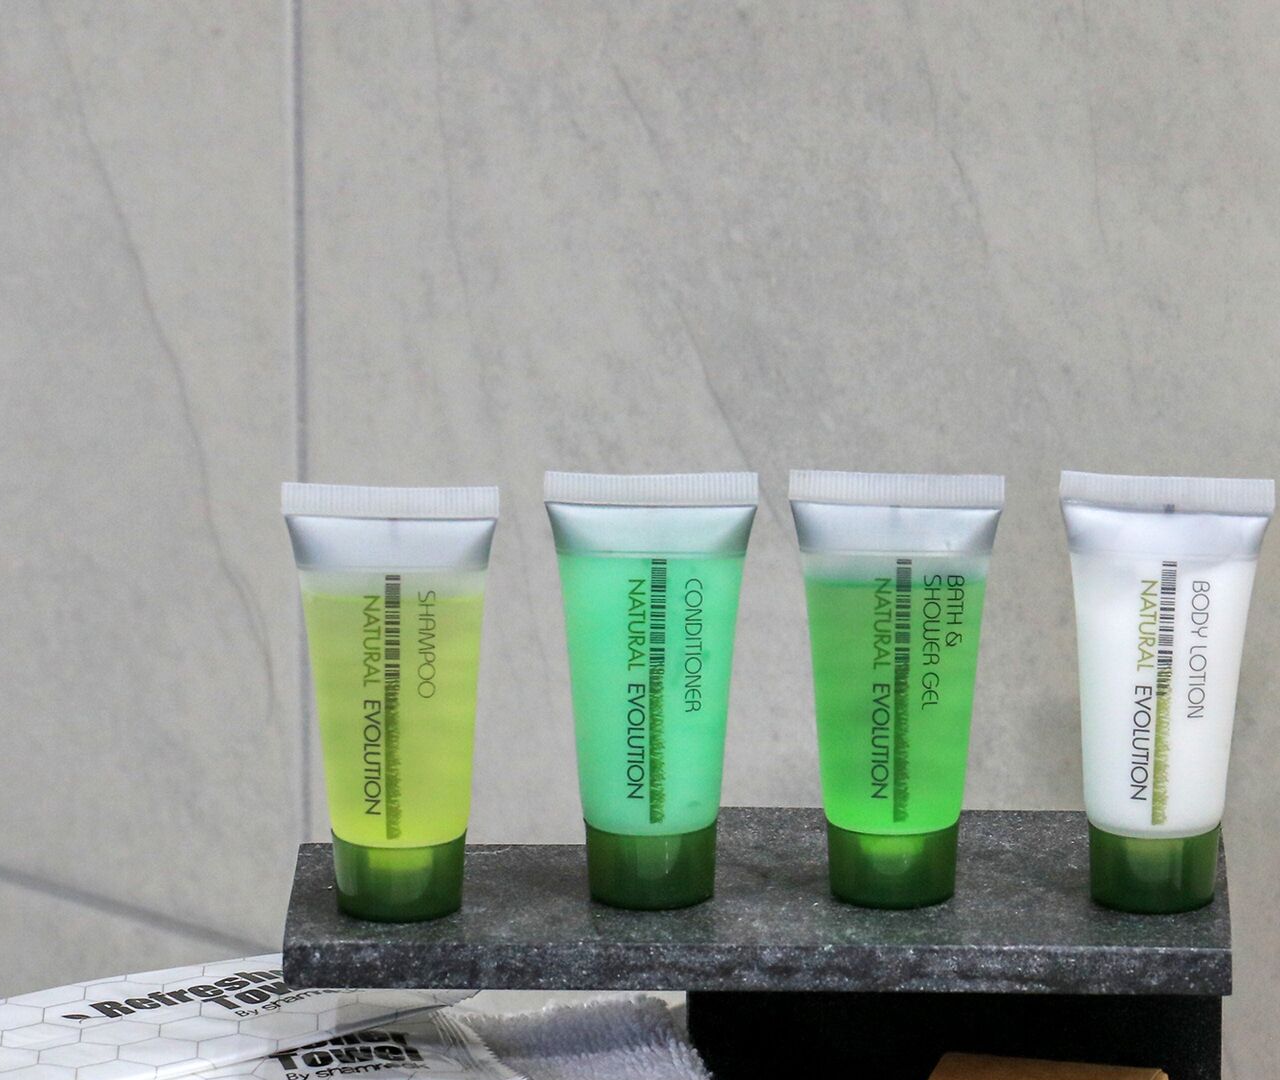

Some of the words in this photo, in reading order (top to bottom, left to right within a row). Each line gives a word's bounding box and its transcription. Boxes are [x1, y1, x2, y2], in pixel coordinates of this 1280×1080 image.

[363, 594, 383, 688] NATURAL
[417, 589, 437, 700] SHAMPOO
[628, 578, 647, 671] NATURAL
[684, 578, 703, 713] CONDITIONER
[873, 577, 892, 670] NATURAL
[922, 574, 942, 666] SHOWER
[945, 631, 963, 647] &
[946, 574, 965, 625] BATH
[1137, 579, 1158, 672] NATURAL
[1190, 580, 1210, 638] BODY
[921, 672, 940, 710] GEL
[1187, 645, 1207, 719] LOTION
[363, 699, 383, 816] EVOLUTION
[627, 683, 646, 800] EVOLUTION
[870, 683, 891, 799] EVOLUTION
[1130, 685, 1153, 801] EVOLUTION
[235, 1008, 260, 1018] By
